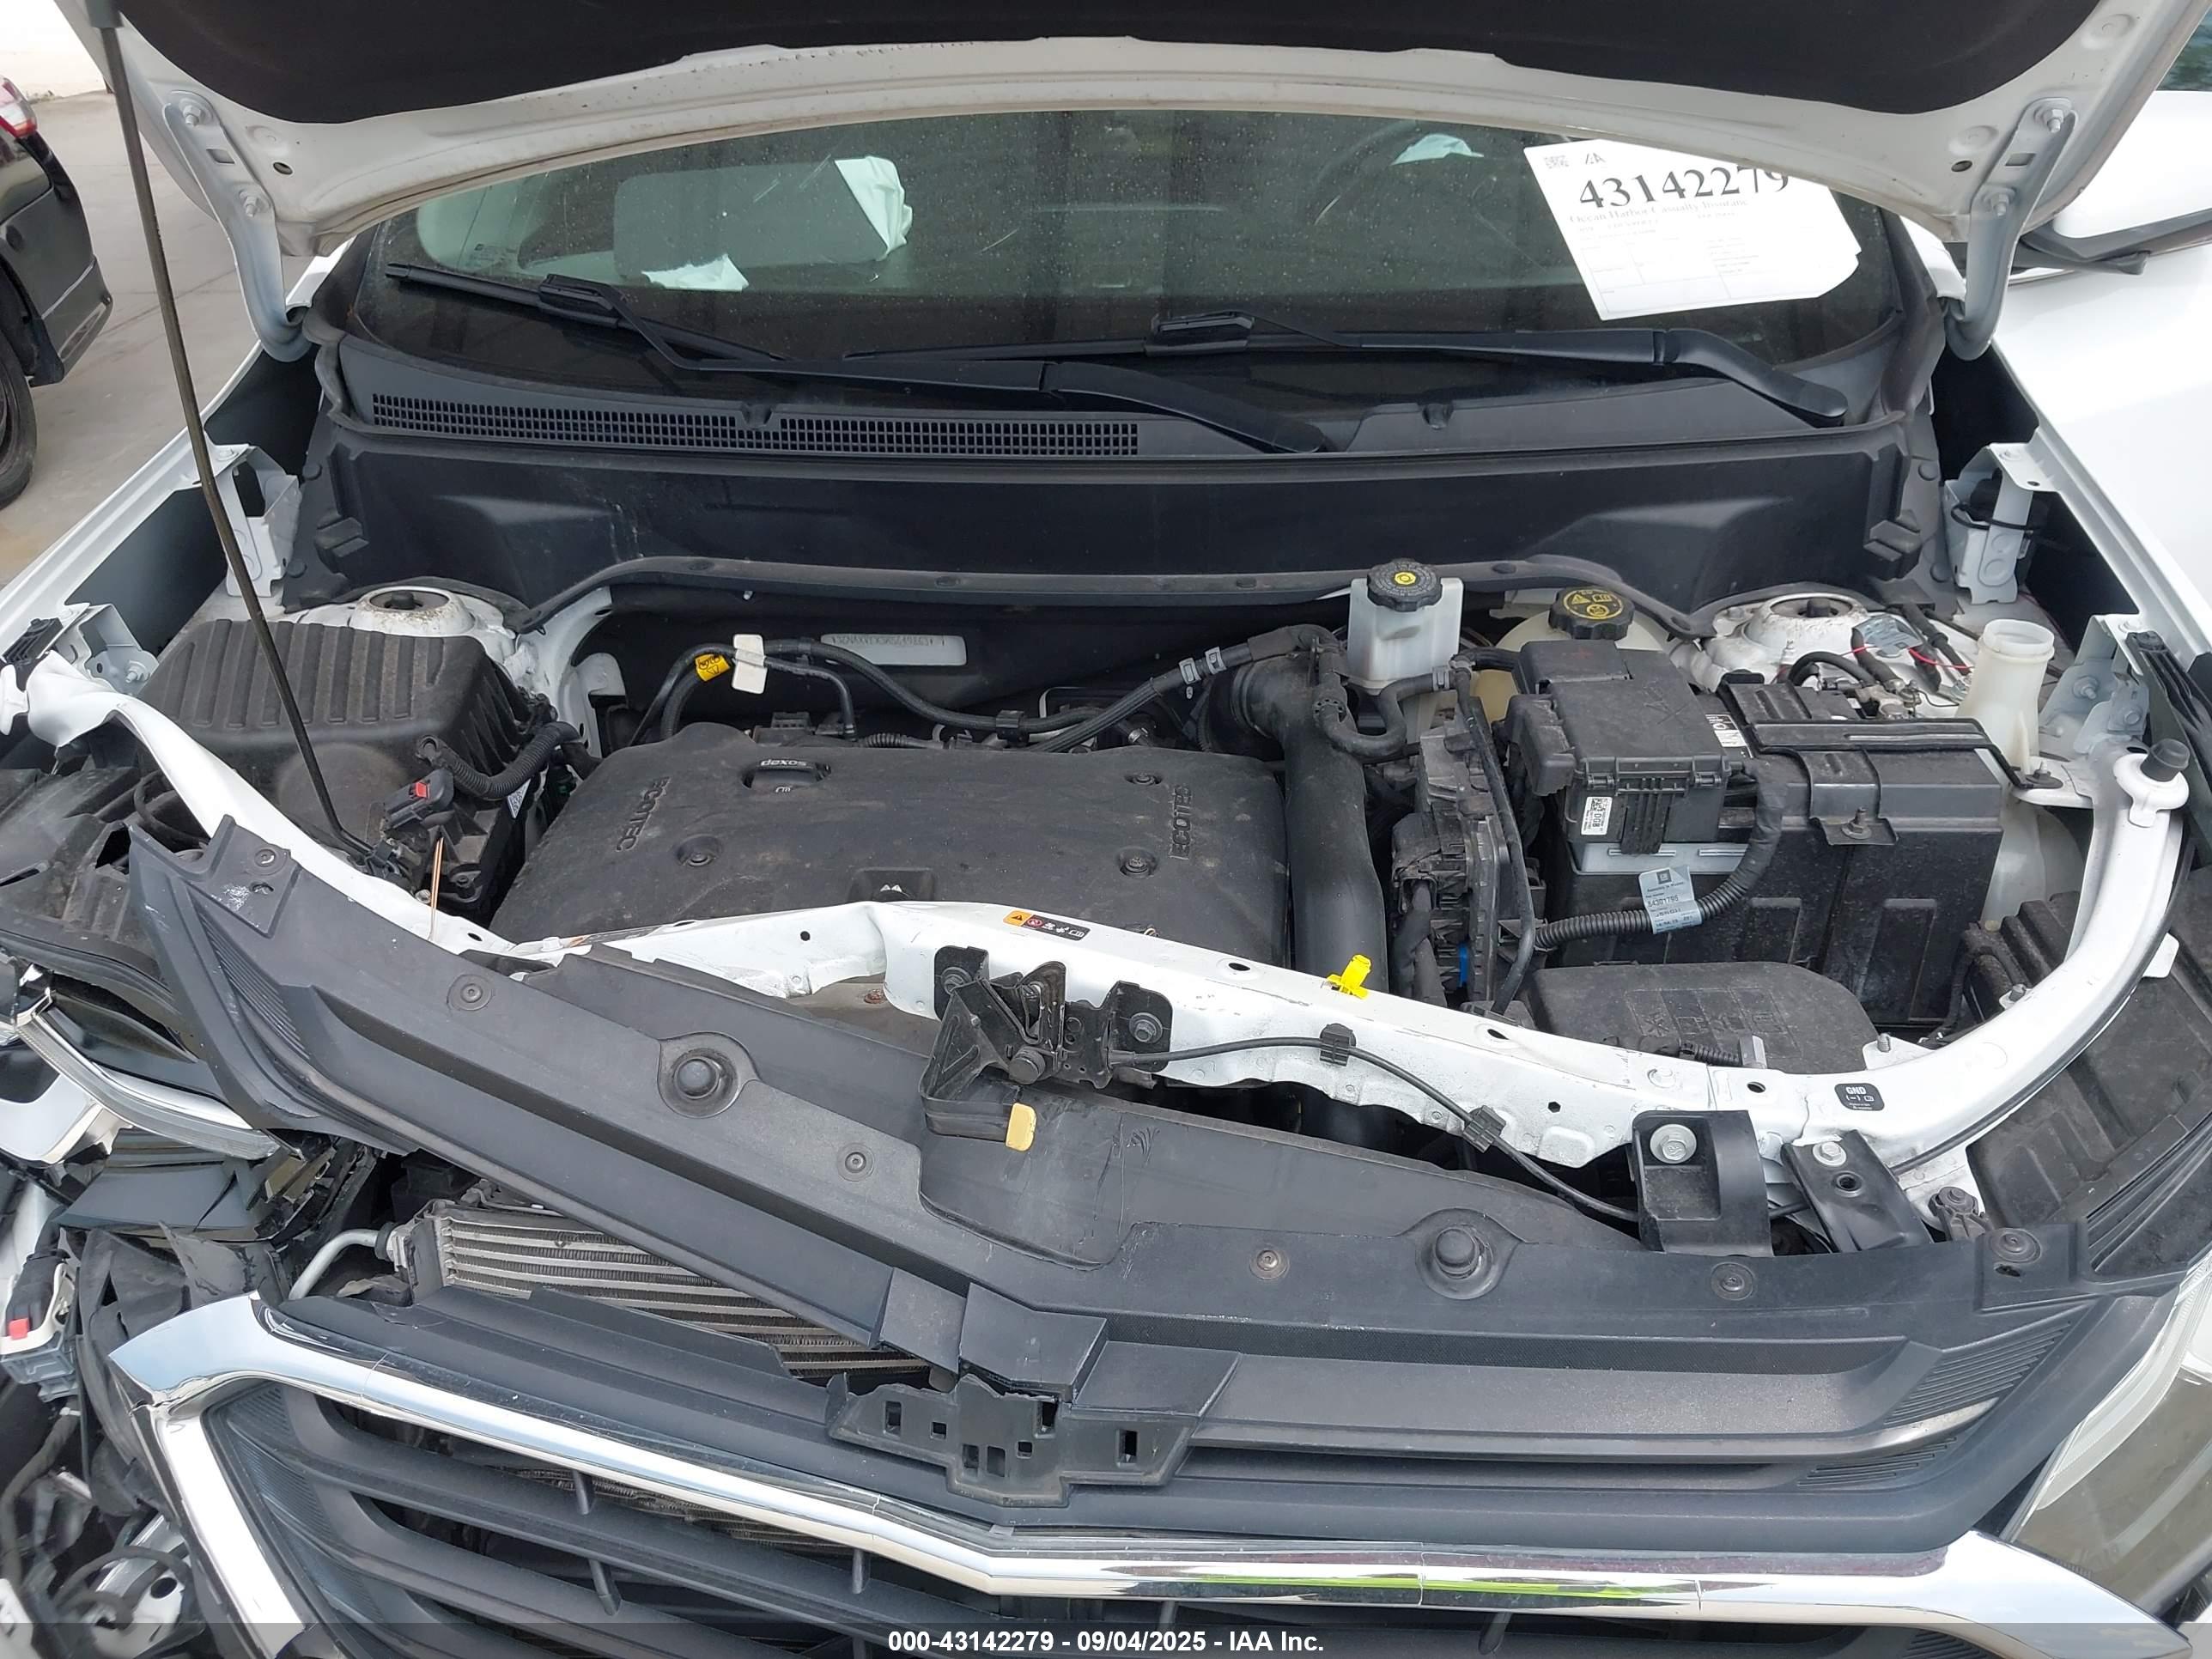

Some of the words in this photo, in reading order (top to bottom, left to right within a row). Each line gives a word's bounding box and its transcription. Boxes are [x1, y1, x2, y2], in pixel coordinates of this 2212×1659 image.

[1580, 166, 1789, 208] 43142279
[617, 775, 671, 852] ECOTEC
[1169, 785, 1193, 860] ECOTEC
[1845, 1086, 1867, 1095] GND
